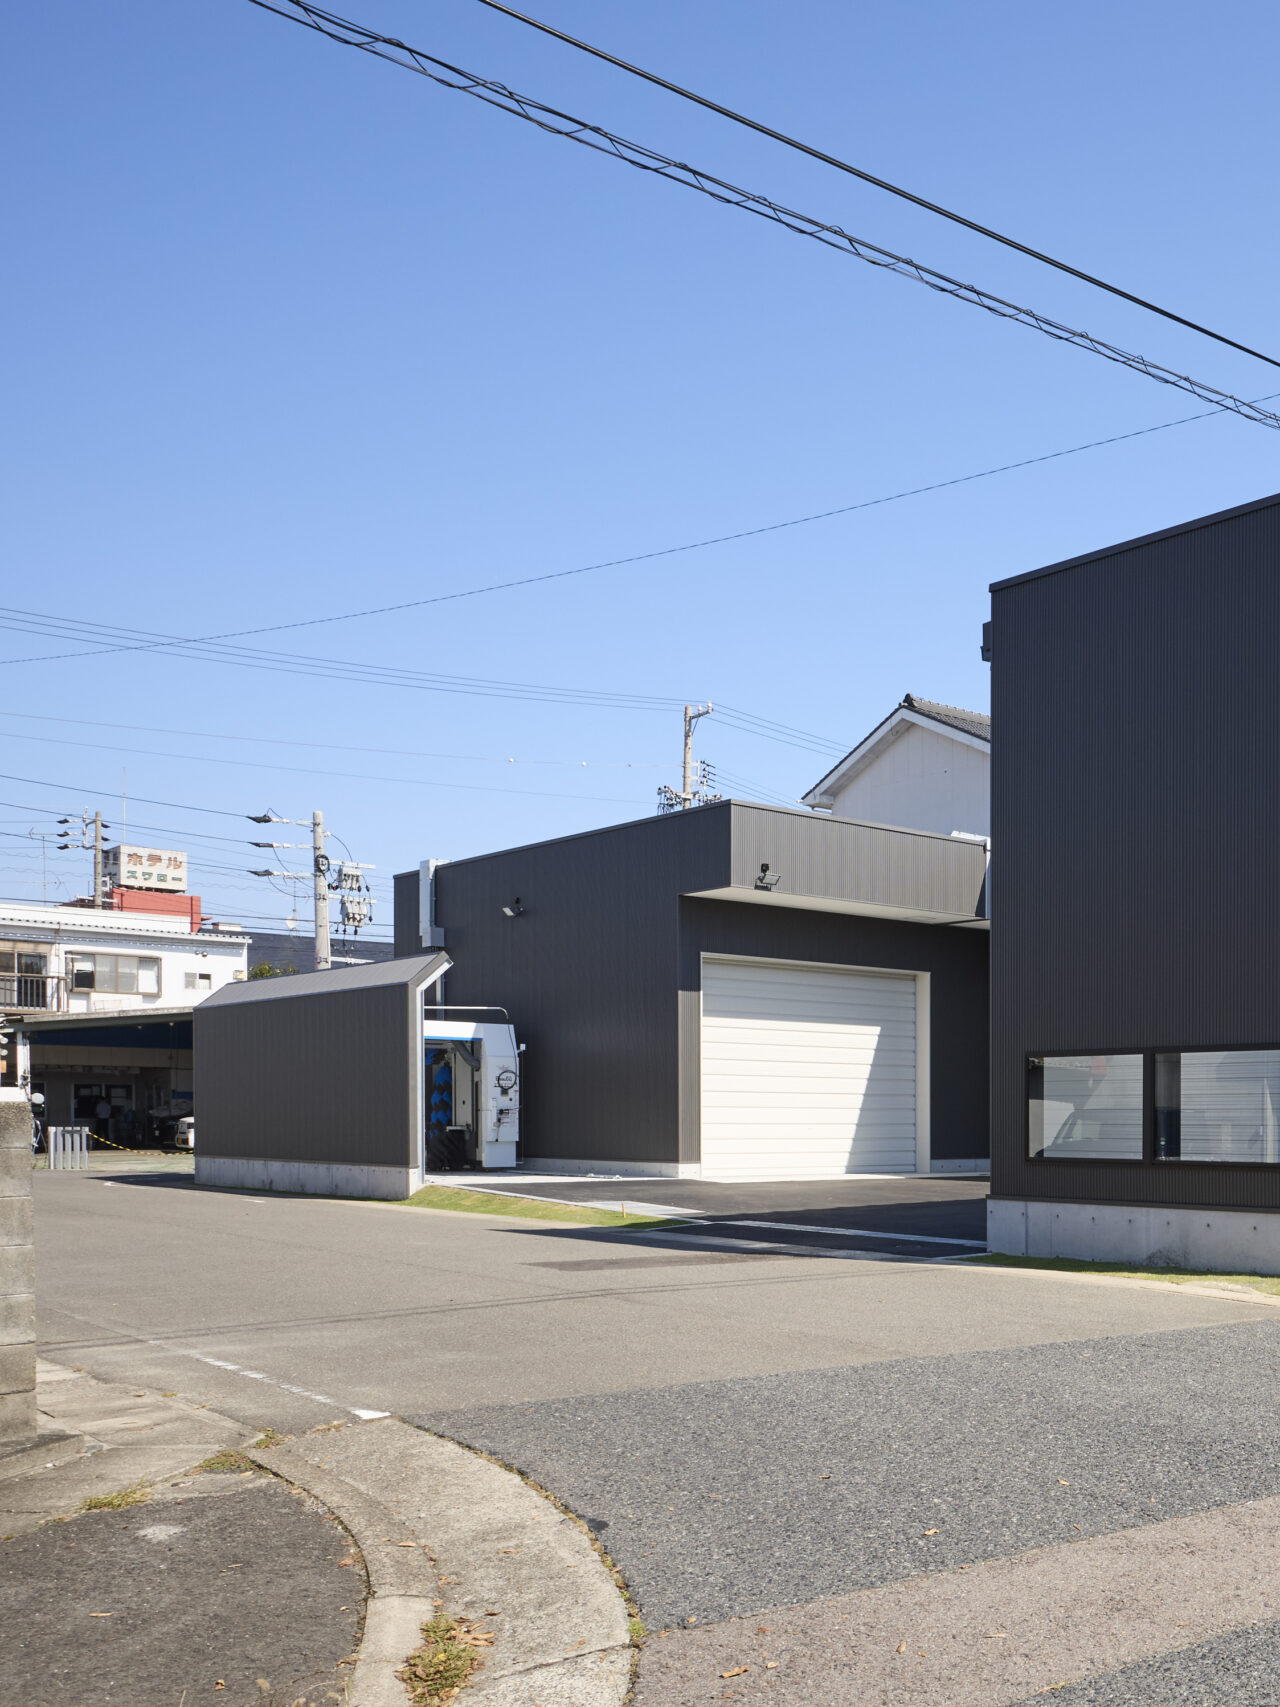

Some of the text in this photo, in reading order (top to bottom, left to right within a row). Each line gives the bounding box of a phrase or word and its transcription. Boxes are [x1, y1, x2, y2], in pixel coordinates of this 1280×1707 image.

[127, 853, 182, 869] ホテル
[127, 870, 182, 882] スワロー
